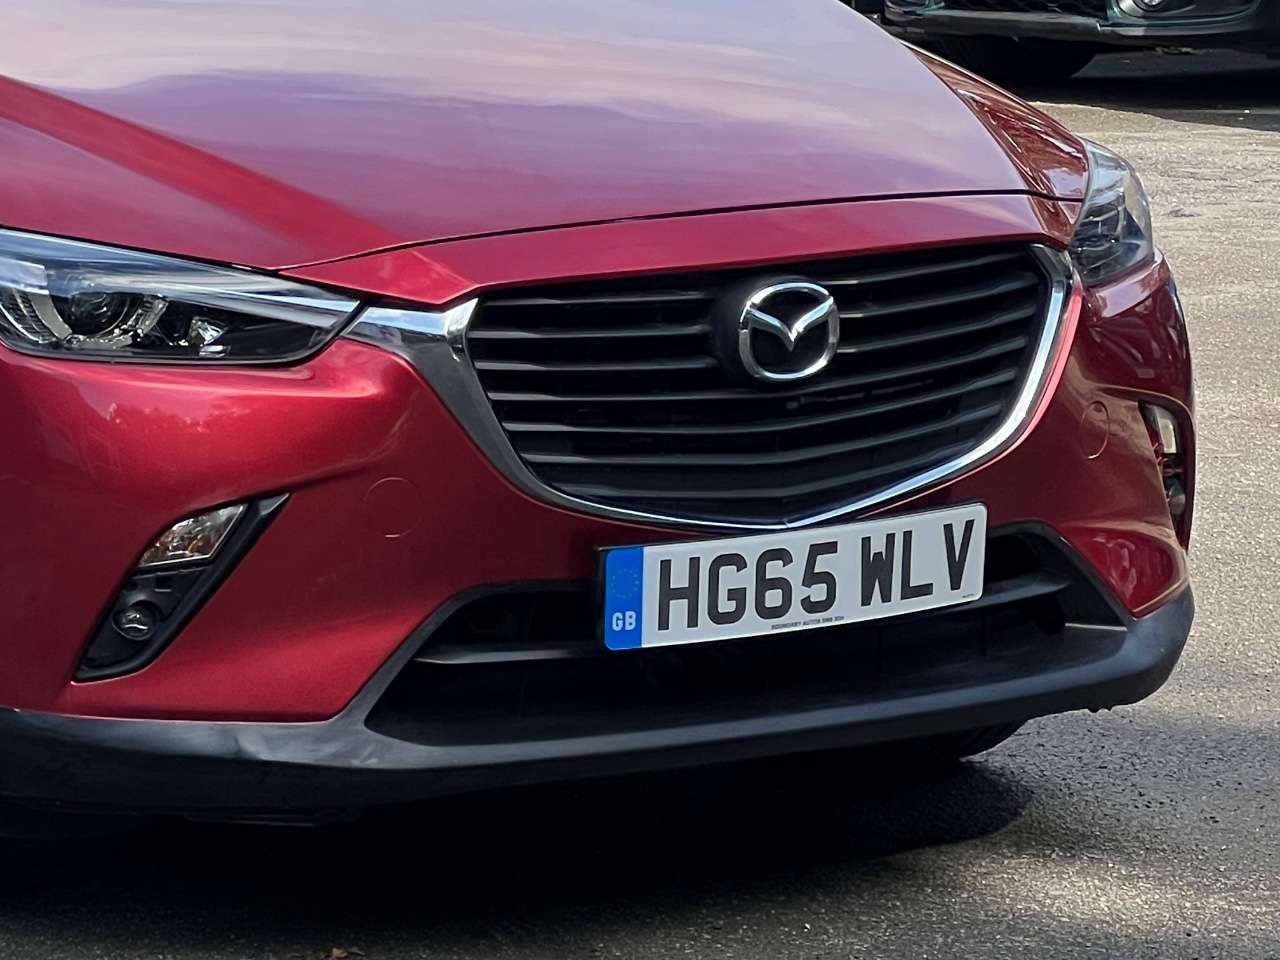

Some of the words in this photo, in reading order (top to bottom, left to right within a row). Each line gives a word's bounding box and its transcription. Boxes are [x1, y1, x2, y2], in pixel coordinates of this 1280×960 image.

[657, 541, 838, 631] HG65
[860, 519, 975, 607] WLV
[612, 611, 636, 631] GB
